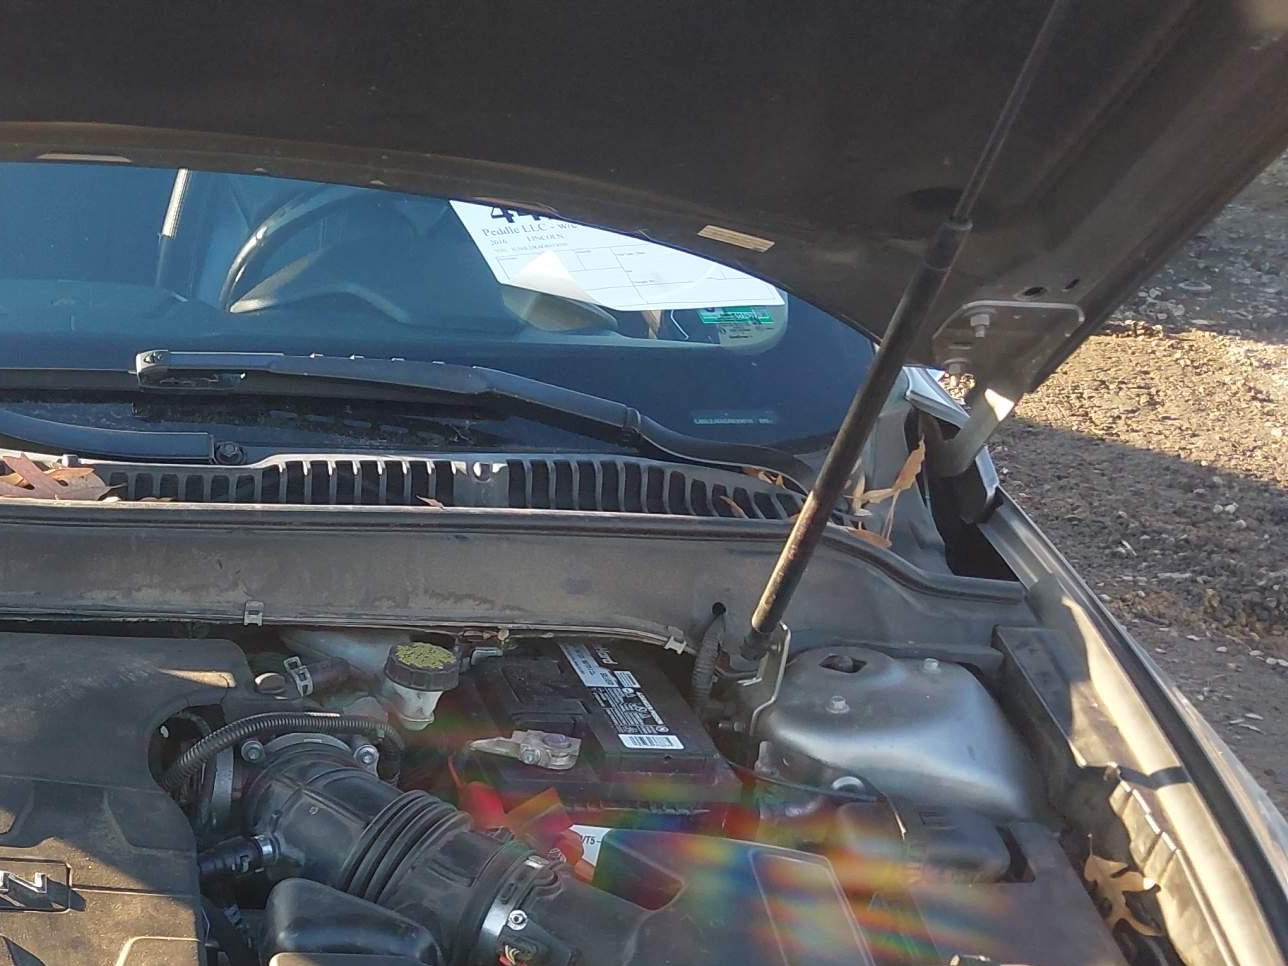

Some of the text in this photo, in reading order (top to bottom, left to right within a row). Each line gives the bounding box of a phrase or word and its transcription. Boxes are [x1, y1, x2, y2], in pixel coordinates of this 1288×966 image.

[481, 225, 520, 236] Peddle
[522, 224, 546, 232] LLC
[526, 234, 565, 242] LINCOLN
